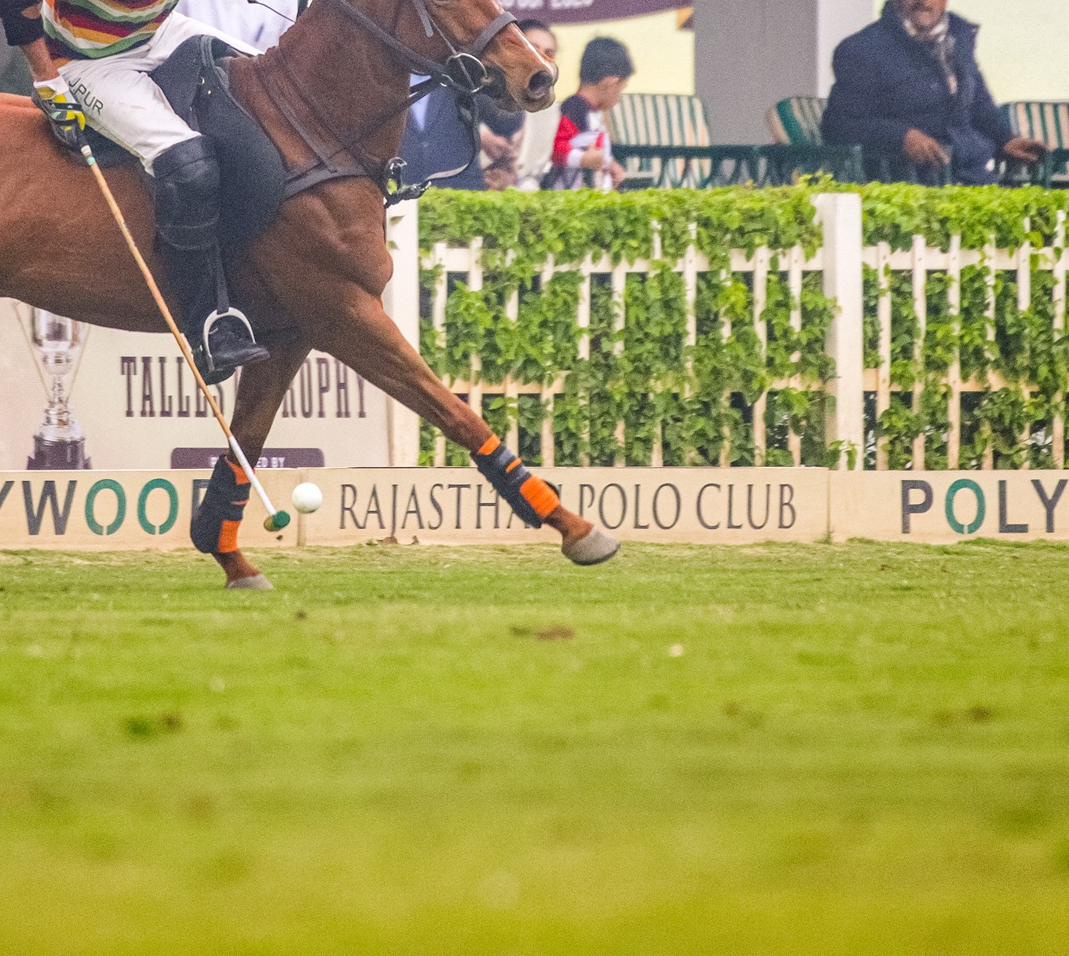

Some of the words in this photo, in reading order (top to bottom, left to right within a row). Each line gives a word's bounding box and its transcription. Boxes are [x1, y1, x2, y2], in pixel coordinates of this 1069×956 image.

[120, 356, 240, 418] TALL
[281, 357, 367, 418] OPHY
[339, 483, 563, 538] RAJASTH
[579, 482, 681, 530] POLO
[696, 482, 797, 530] CLUB
[901, 478, 1069, 534] POLY
